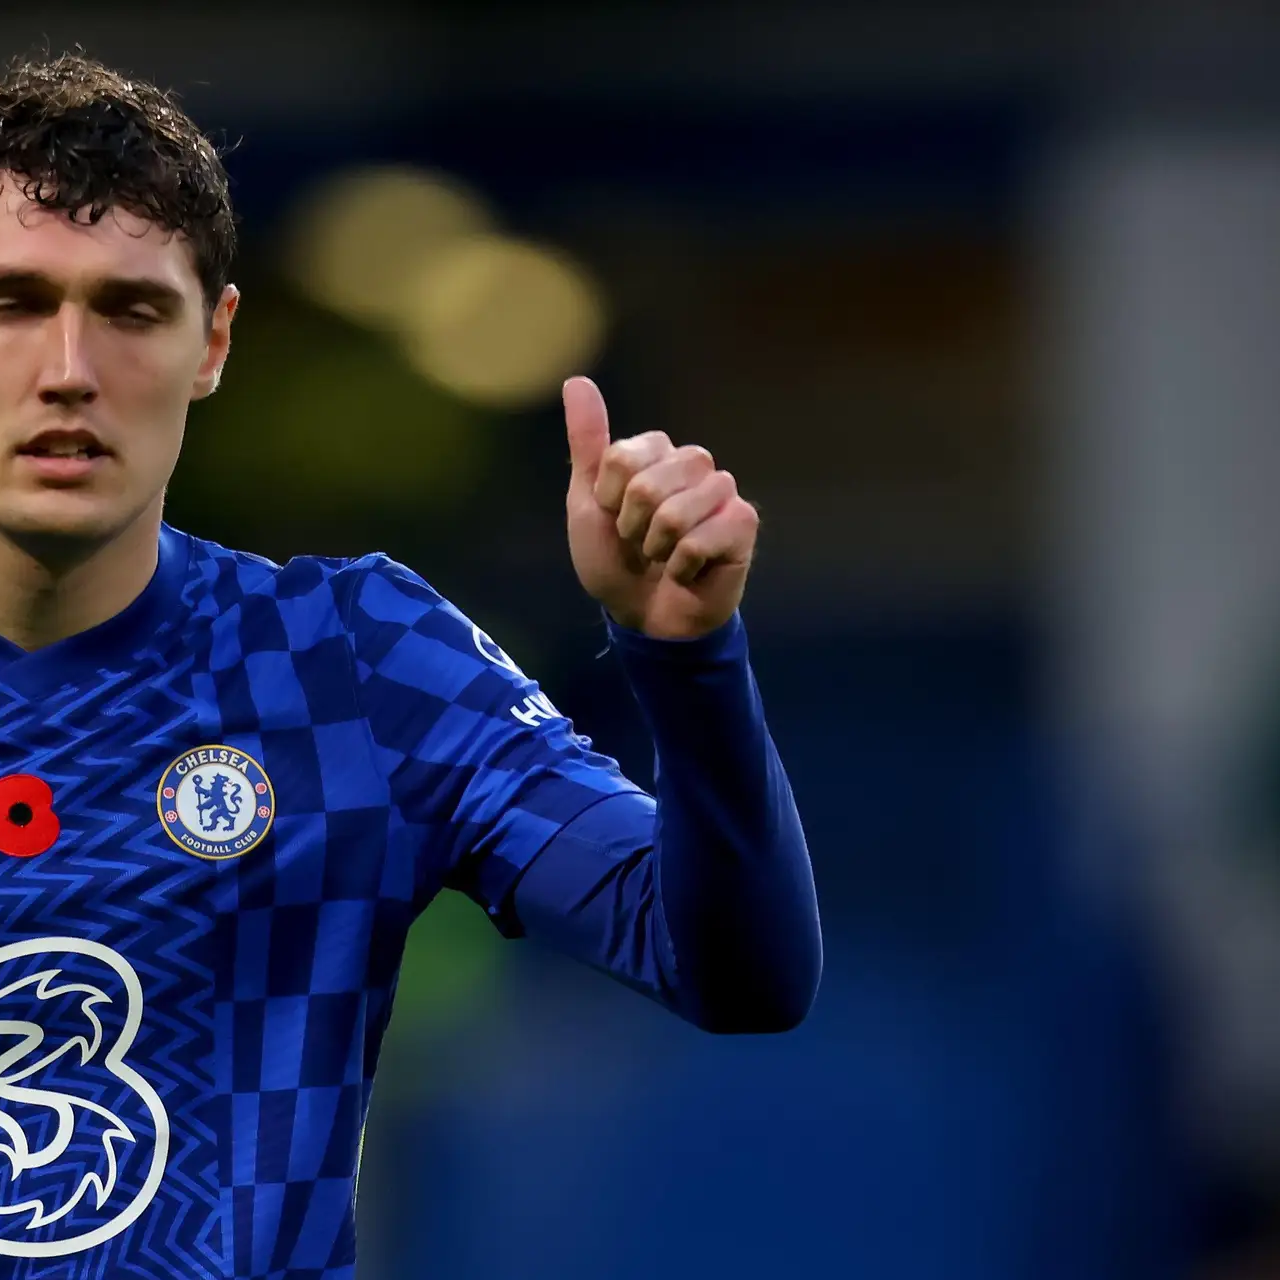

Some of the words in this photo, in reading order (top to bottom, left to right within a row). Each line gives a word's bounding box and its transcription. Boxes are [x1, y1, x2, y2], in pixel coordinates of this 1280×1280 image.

[175, 749, 249, 775] CHELSEA
[180, 833, 232, 854] FOOTBALL
[234, 830, 258, 848] CLUB
